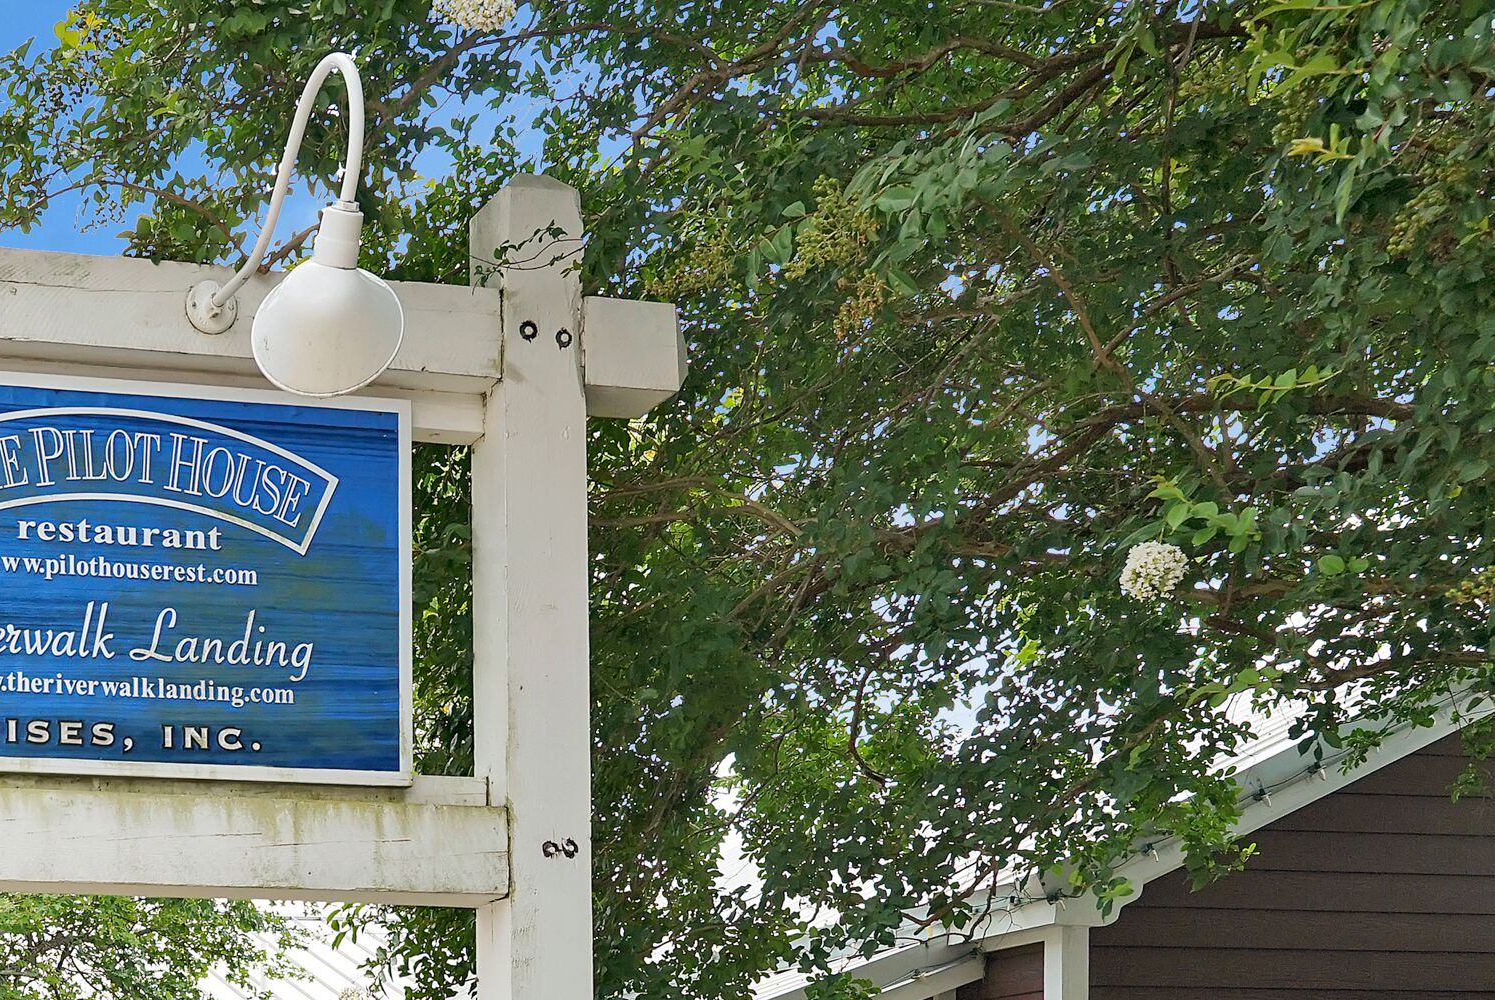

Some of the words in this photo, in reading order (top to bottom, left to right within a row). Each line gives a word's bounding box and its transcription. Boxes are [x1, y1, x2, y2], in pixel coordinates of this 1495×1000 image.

[27, 427, 161, 487] PILOT
[162, 432, 311, 528] HOUSE
[16, 517, 223, 551] restaurant
[129, 606, 314, 683] Landing
[161, 721, 264, 753] INC.
